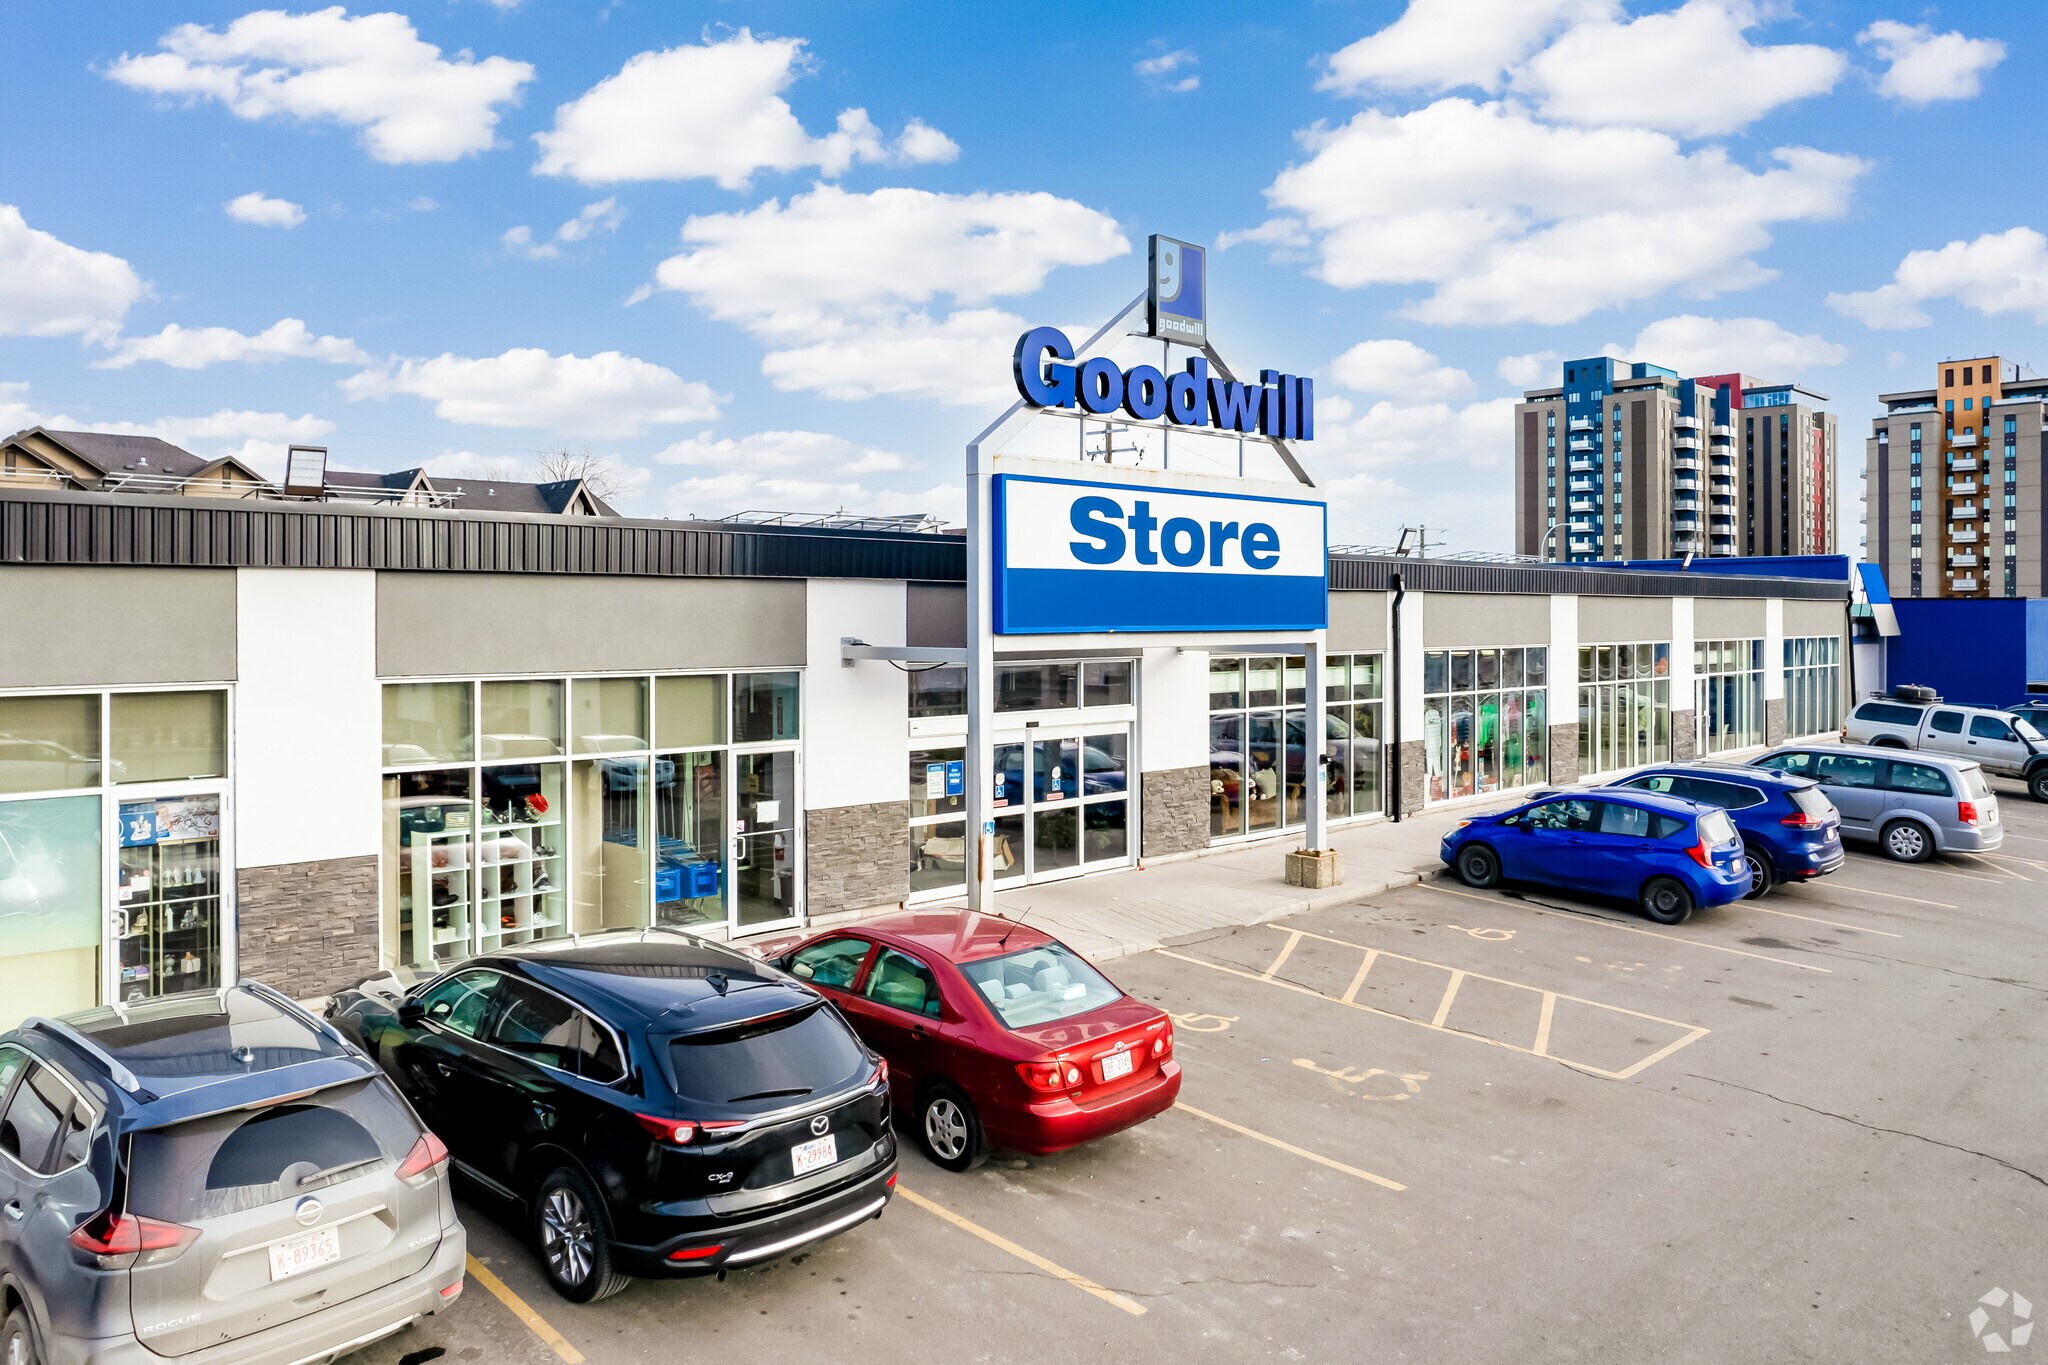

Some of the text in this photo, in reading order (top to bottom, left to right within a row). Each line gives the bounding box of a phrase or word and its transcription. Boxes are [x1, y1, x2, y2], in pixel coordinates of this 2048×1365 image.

[1159, 317, 1204, 336] goodwill
[1013, 326, 1314, 442] Goodwill
[1069, 495, 1281, 570] Store
[797, 1144, 833, 1167] K-29984
[707, 1171, 734, 1181] CX-9
[277, 1238, 333, 1270] K-89365
[143, 1312, 202, 1333] ROGUE
